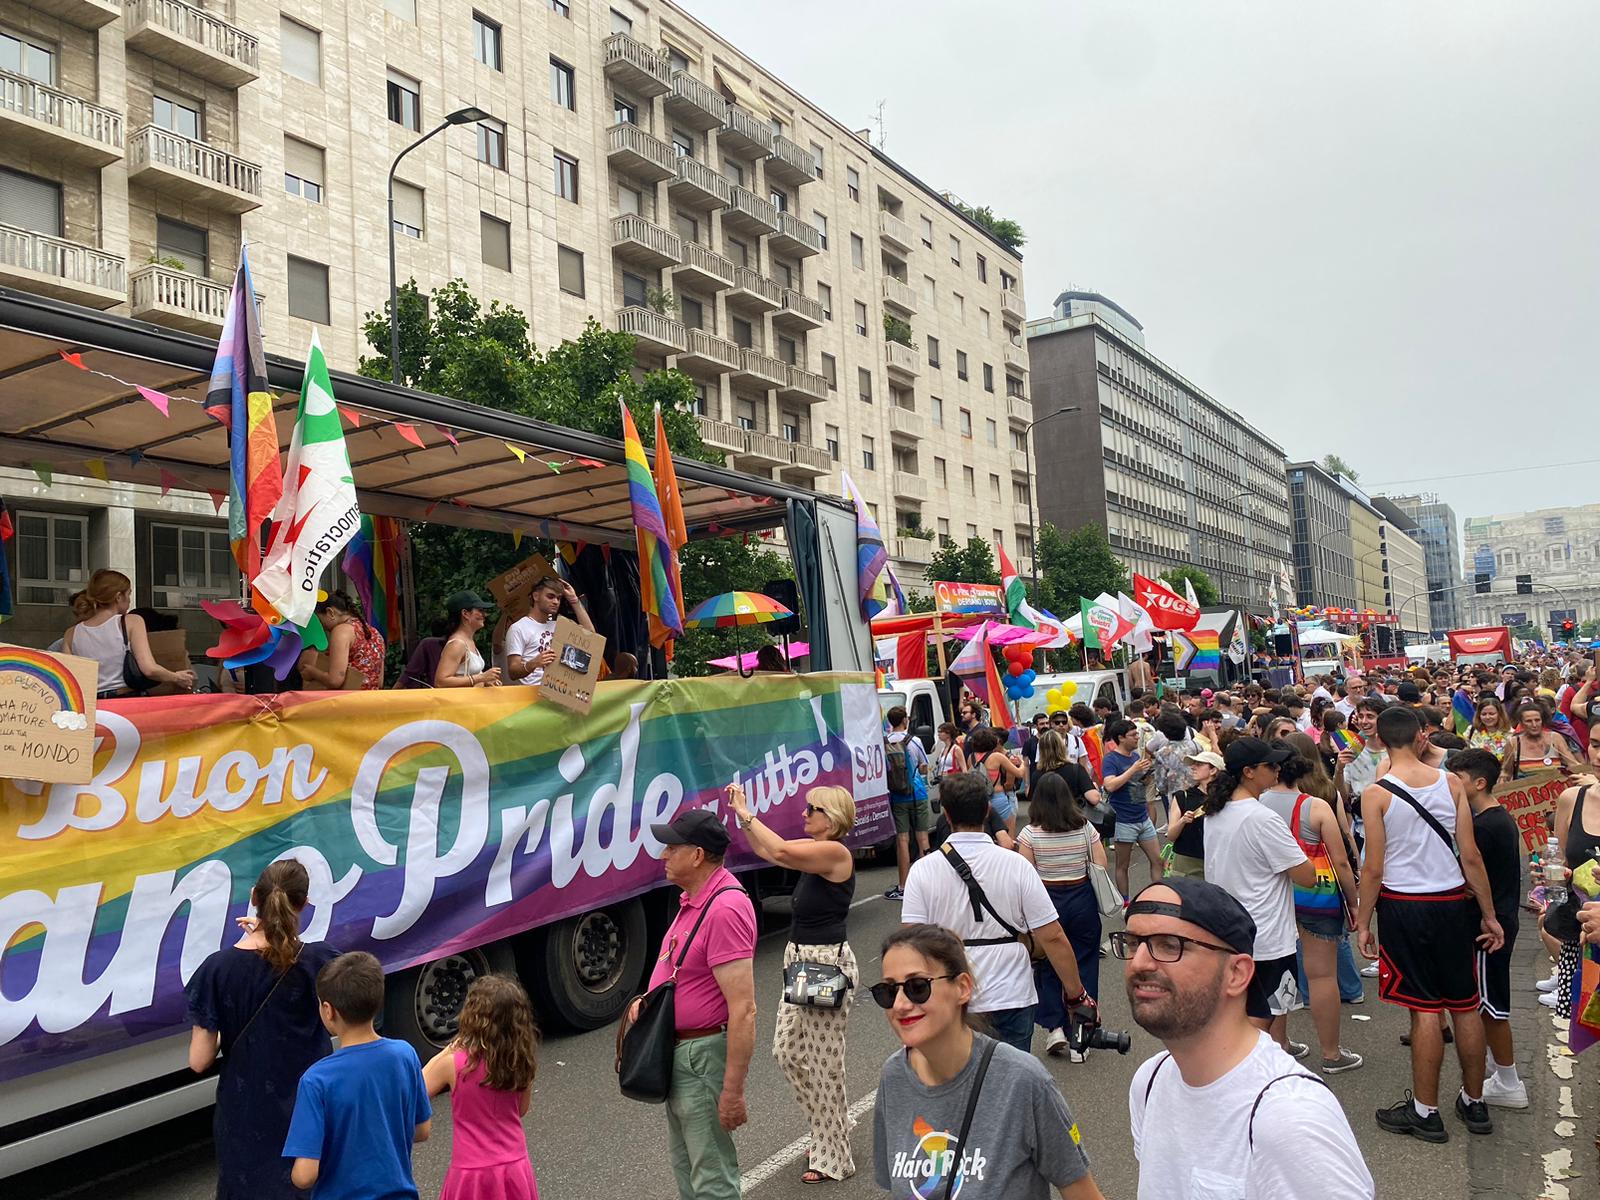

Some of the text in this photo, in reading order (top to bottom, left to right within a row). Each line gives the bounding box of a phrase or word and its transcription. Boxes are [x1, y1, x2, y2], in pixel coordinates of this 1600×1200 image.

[21, 741, 80, 765] MONDO
[854, 744, 884, 784] S&D
[17, 709, 328, 841] Buon
[351, 703, 684, 940] Pride
[892, 1147, 987, 1181] Hard Rck
